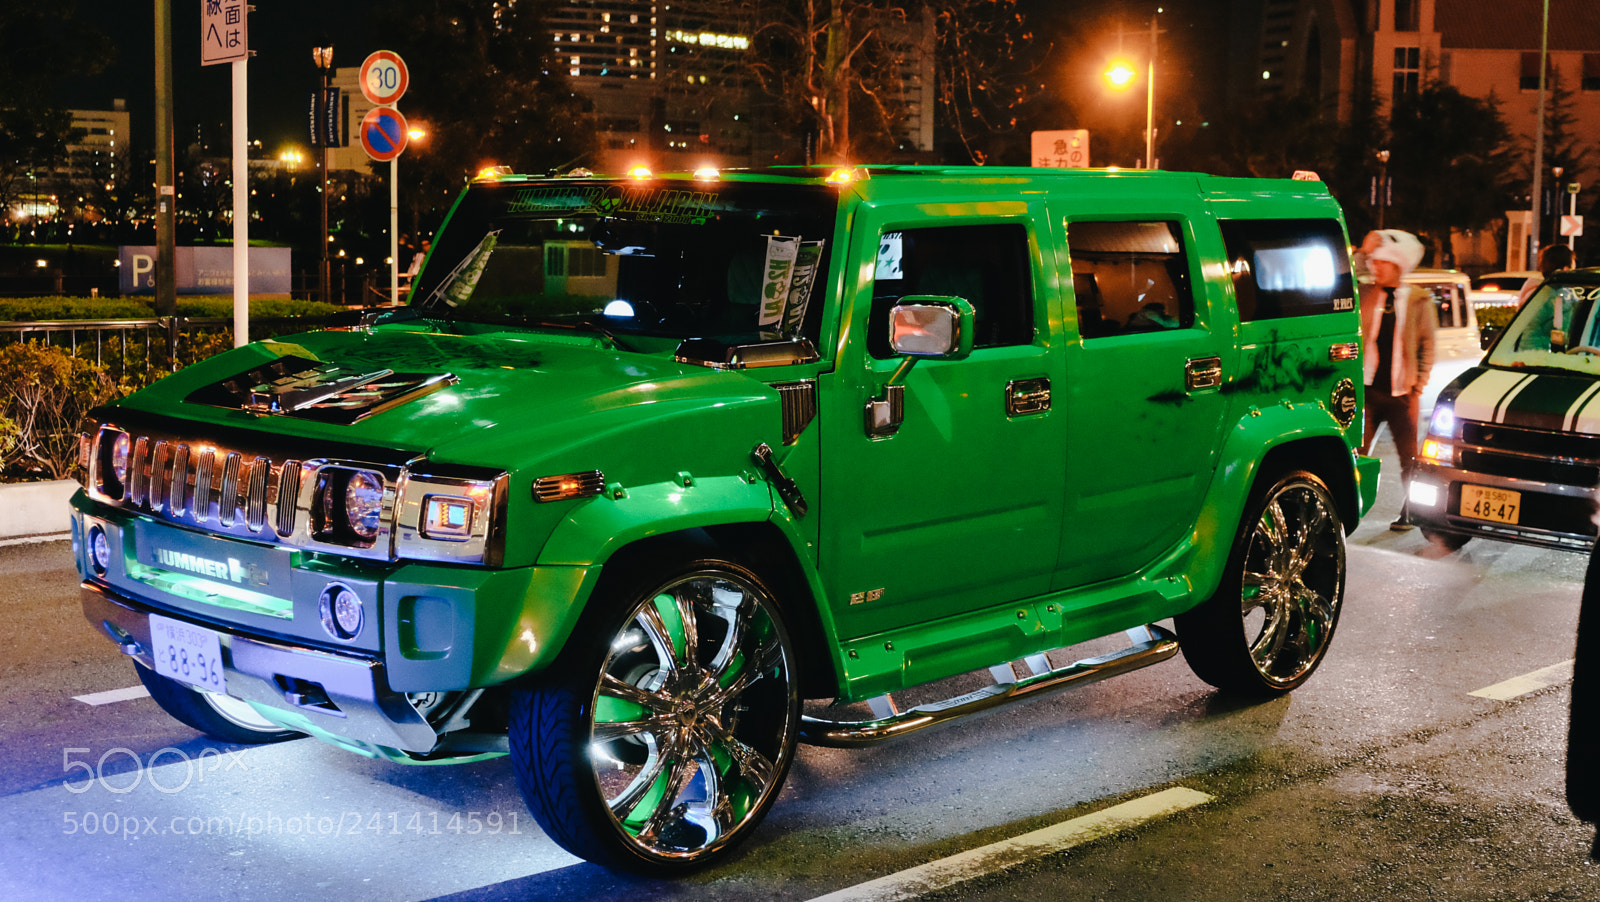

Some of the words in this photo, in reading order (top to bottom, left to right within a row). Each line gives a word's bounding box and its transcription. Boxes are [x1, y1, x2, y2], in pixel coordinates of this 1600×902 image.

[225, 0, 241, 49] 面は
[371, 67, 397, 89] 30
[132, 254, 153, 288] P
[1473, 500, 1516, 520] 48-47
[168, 644, 219, 686] 88-96
